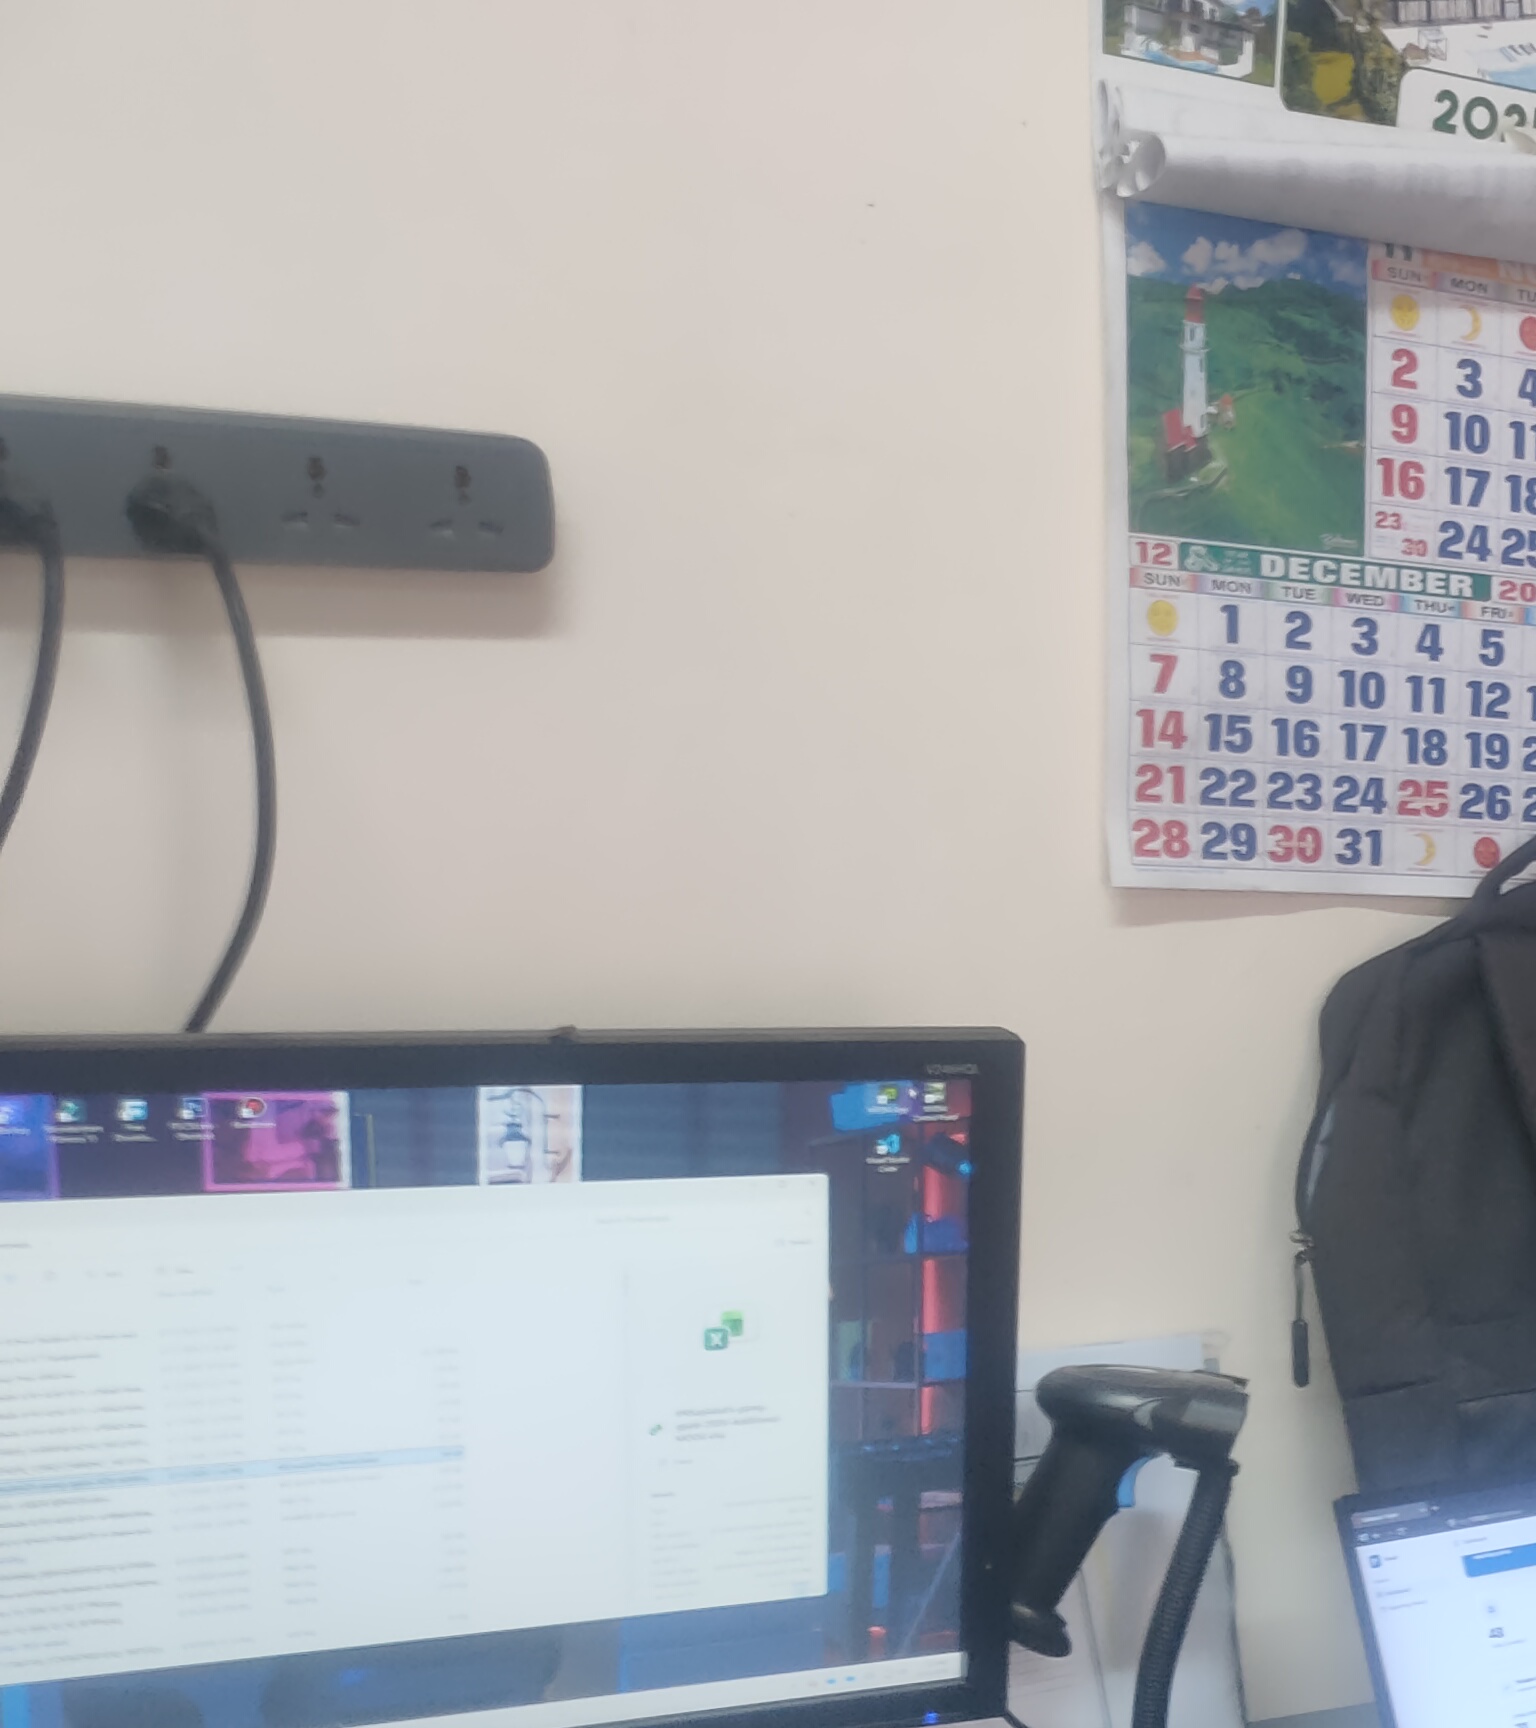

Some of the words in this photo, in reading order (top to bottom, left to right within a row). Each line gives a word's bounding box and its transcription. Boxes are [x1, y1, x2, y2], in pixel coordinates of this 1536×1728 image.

[1387, 265, 1421, 282] SUN
[1450, 276, 1489, 294] MON
[1391, 348, 1418, 389] 2
[1456, 359, 1482, 399] 3
[1391, 404, 1418, 444] 9
[1444, 412, 1490, 454] 10
[1377, 458, 1425, 500] 16
[1444, 467, 1490, 507] 17
[1375, 511, 1404, 530] 23
[1438, 521, 1492, 562] 24
[1401, 538, 1428, 557] 30
[1135, 541, 1173, 566] 12
[1260, 553, 1475, 598] DECEMBER
[1143, 571, 1181, 588] SUN
[1211, 579, 1251, 594] MON
[1281, 586, 1317, 600] TUE
[1346, 592, 1385, 607] WED
[1416, 600, 1446, 613] THU
[1481, 605, 1507, 619] FRI
[1220, 604, 1239, 644] 1
[1285, 611, 1312, 650] 2
[1351, 617, 1378, 656] 3
[1416, 624, 1444, 661] 4
[1479, 629, 1505, 666] 5
[1150, 653, 1178, 694] 7
[1218, 660, 1246, 699] 8
[1285, 665, 1313, 704] 9
[1338, 670, 1385, 709] 10
[1405, 675, 1445, 714] 11
[1466, 681, 1511, 719] 12
[1136, 709, 1188, 750] 14
[1204, 713, 1252, 753] 15
[1271, 718, 1320, 758] 16
[1340, 723, 1387, 761] 17
[1402, 727, 1448, 766] 18
[1465, 732, 1509, 770] 19
[1135, 764, 1185, 804] 21
[1199, 767, 1257, 807] 22
[1267, 771, 1322, 811] 23
[1333, 775, 1388, 814] 24
[1397, 779, 1449, 817] 25
[1459, 783, 1511, 821] 26
[1132, 818, 1192, 859] 28
[1201, 821, 1257, 861] 29
[1267, 825, 1323, 863] 30
[1335, 828, 1382, 866] 31
